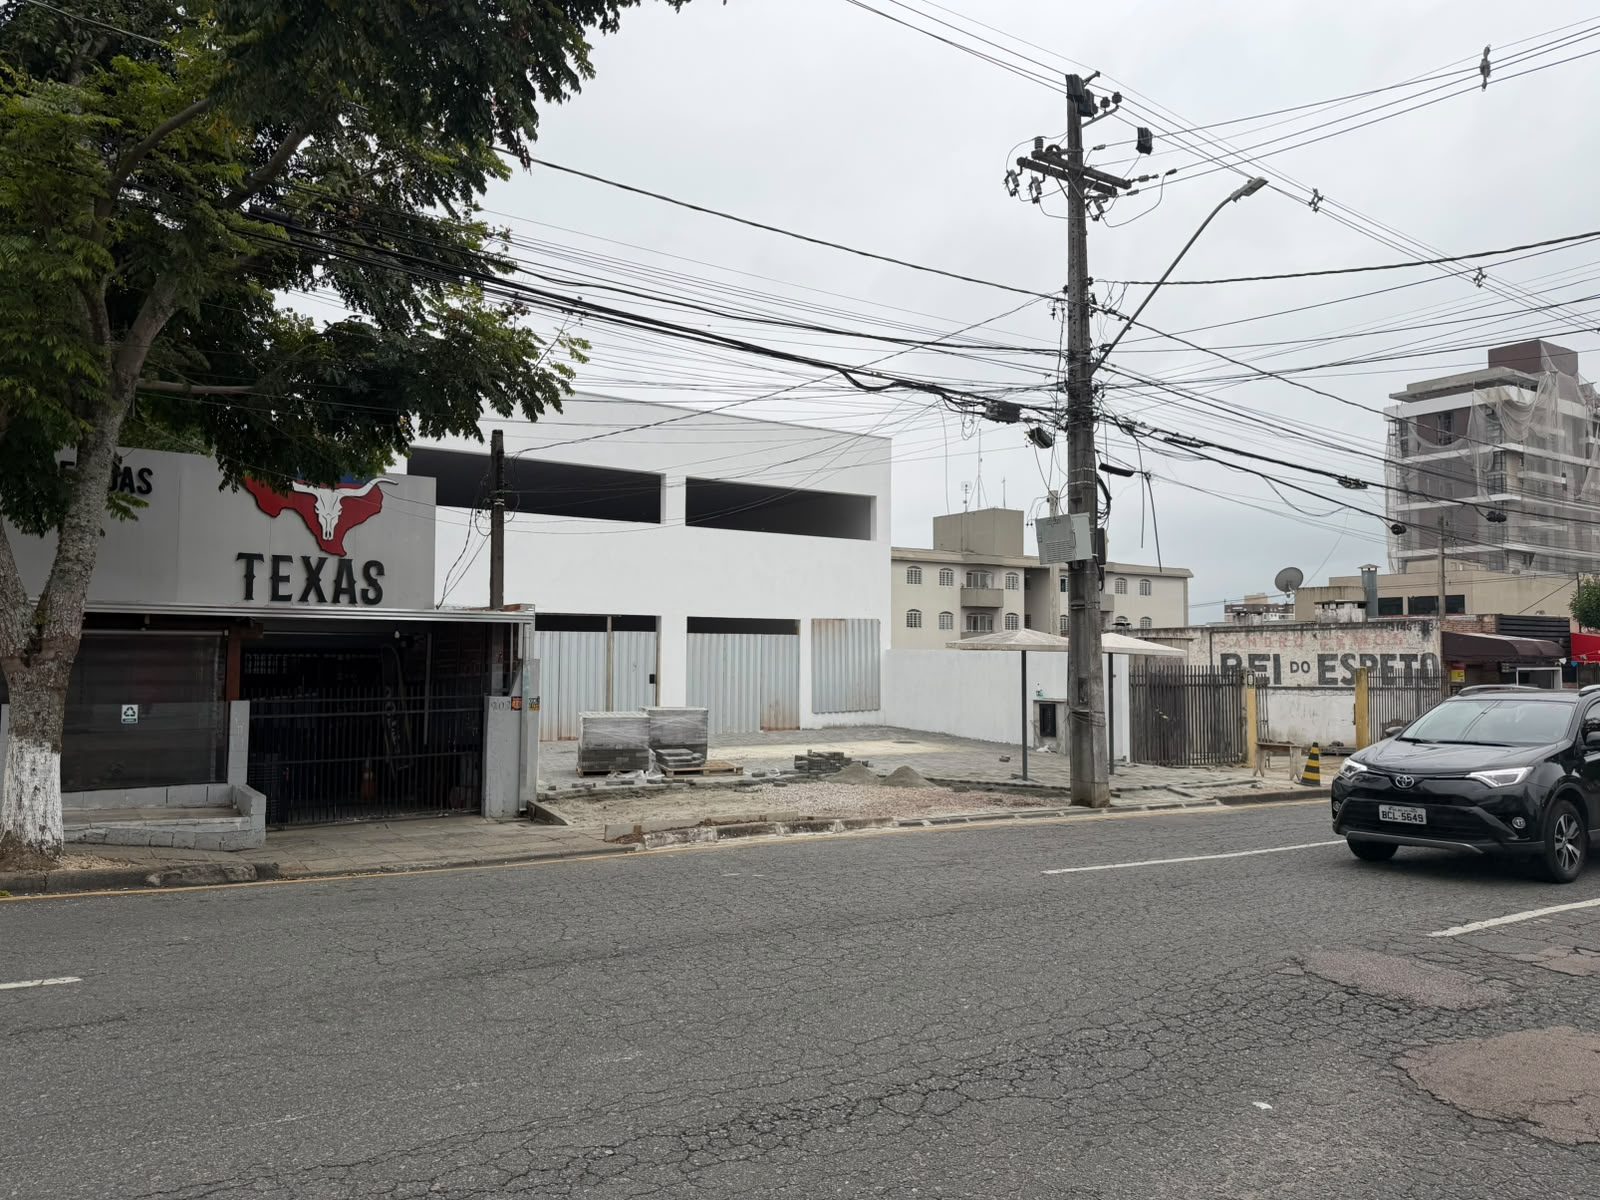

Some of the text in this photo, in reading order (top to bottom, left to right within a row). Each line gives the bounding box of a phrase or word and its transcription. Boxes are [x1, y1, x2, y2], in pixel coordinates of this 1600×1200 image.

[235, 552, 385, 605] TEXAS
[1290, 661, 1311, 674] DO
[1317, 652, 1440, 686] ESPETO
